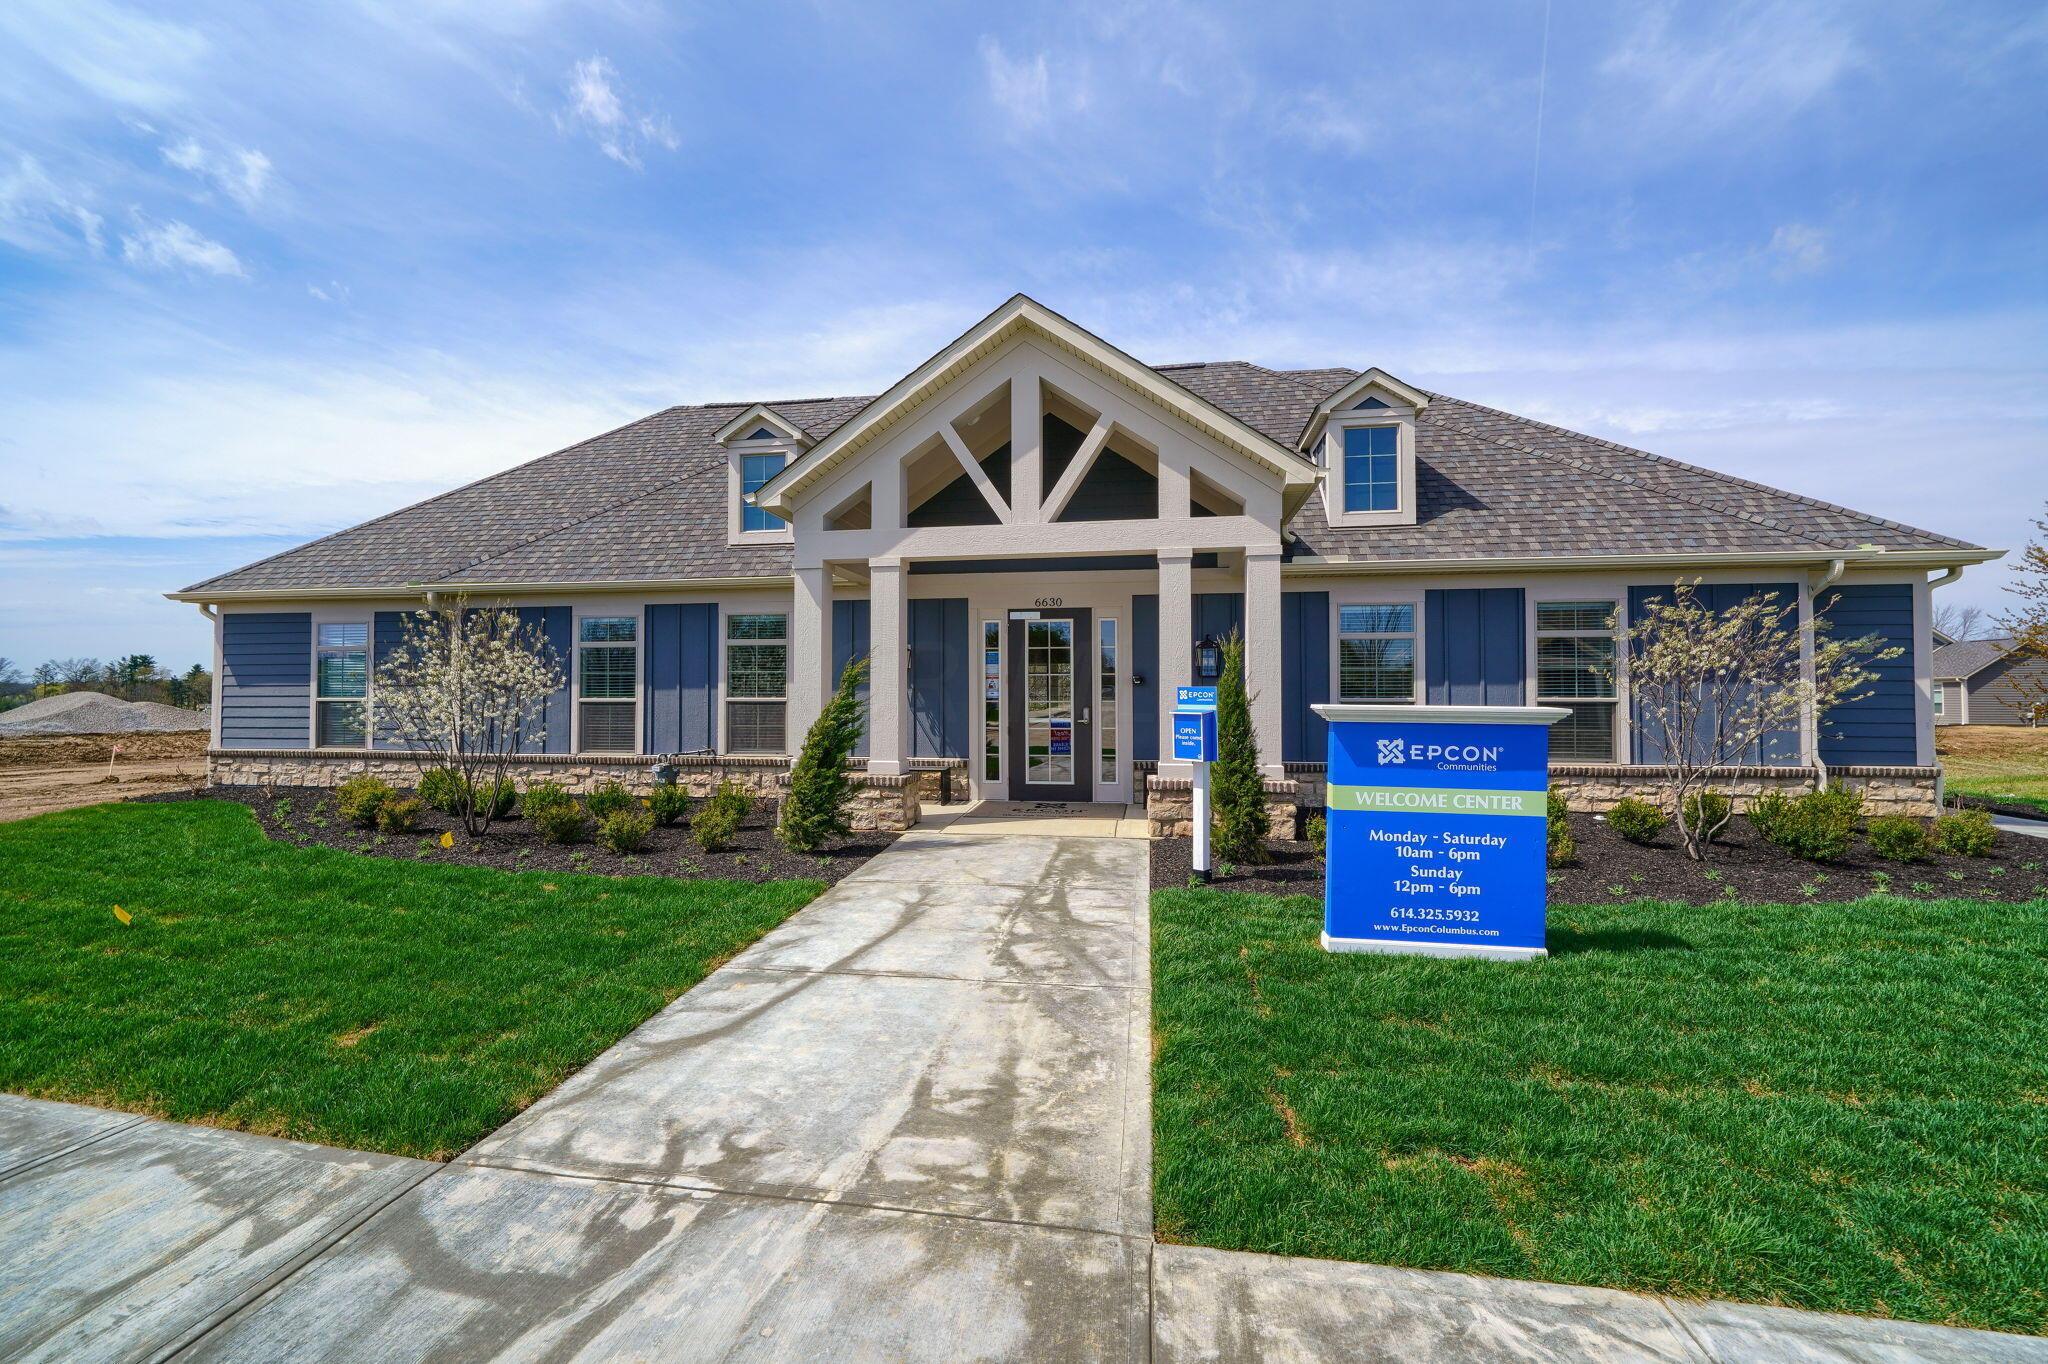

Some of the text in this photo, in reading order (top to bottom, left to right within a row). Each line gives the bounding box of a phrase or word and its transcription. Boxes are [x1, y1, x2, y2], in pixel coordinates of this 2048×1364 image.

[1034, 597, 1063, 607] 6630
[1437, 761, 1497, 772] Communities
[1355, 791, 1523, 810] WELCOME CENTER
[1369, 830, 1428, 844] Monday
[1443, 832, 1507, 849] Saturday
[1395, 846, 1433, 859] 10am
[1448, 848, 1480, 863] 6pm
[1410, 865, 1463, 881] Sunday
[1393, 880, 1434, 895] 12pm
[1448, 882, 1481, 897] 6pm
[1390, 908, 1480, 922] 614.325.5932
[1373, 924, 1500, 937] www.EpconColumbus.com
